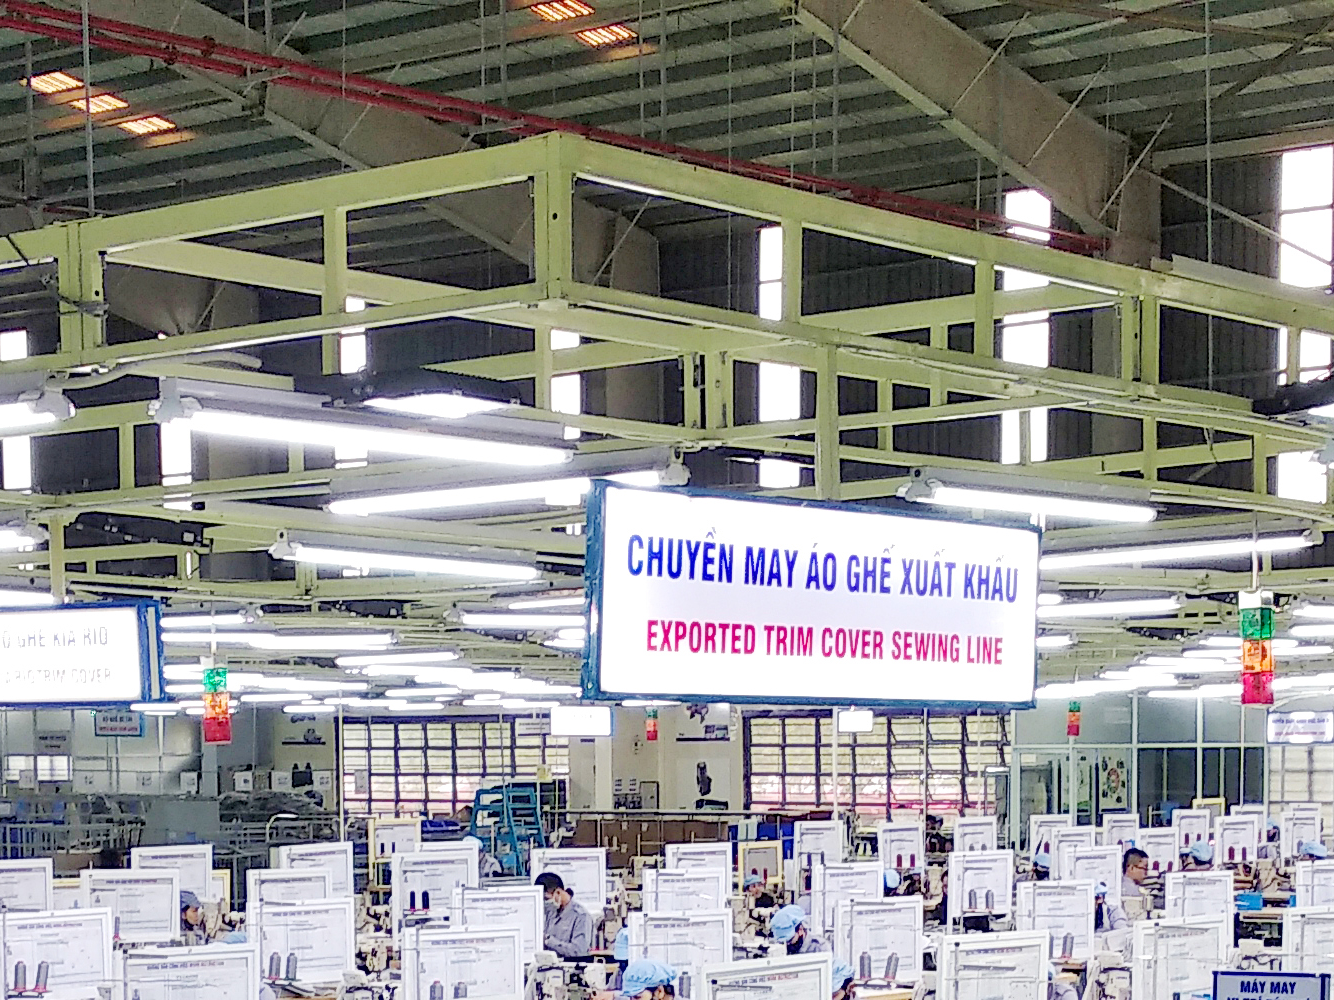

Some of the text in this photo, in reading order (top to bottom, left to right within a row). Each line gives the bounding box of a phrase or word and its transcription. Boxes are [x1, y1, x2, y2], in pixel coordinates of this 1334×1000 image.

[627, 527, 733, 583] CHUYỀN
[745, 545, 797, 589] MAY
[806, 542, 836, 591] ÁO
[847, 543, 895, 594] GHẾ
[900, 548, 956, 598] XUẤT
[83, 626, 108, 646] RIO
[646, 619, 1003, 665] EXPORTED TRIM COVER SEWING LINE
[1240, 979, 1296, 995] MÁY MAY
